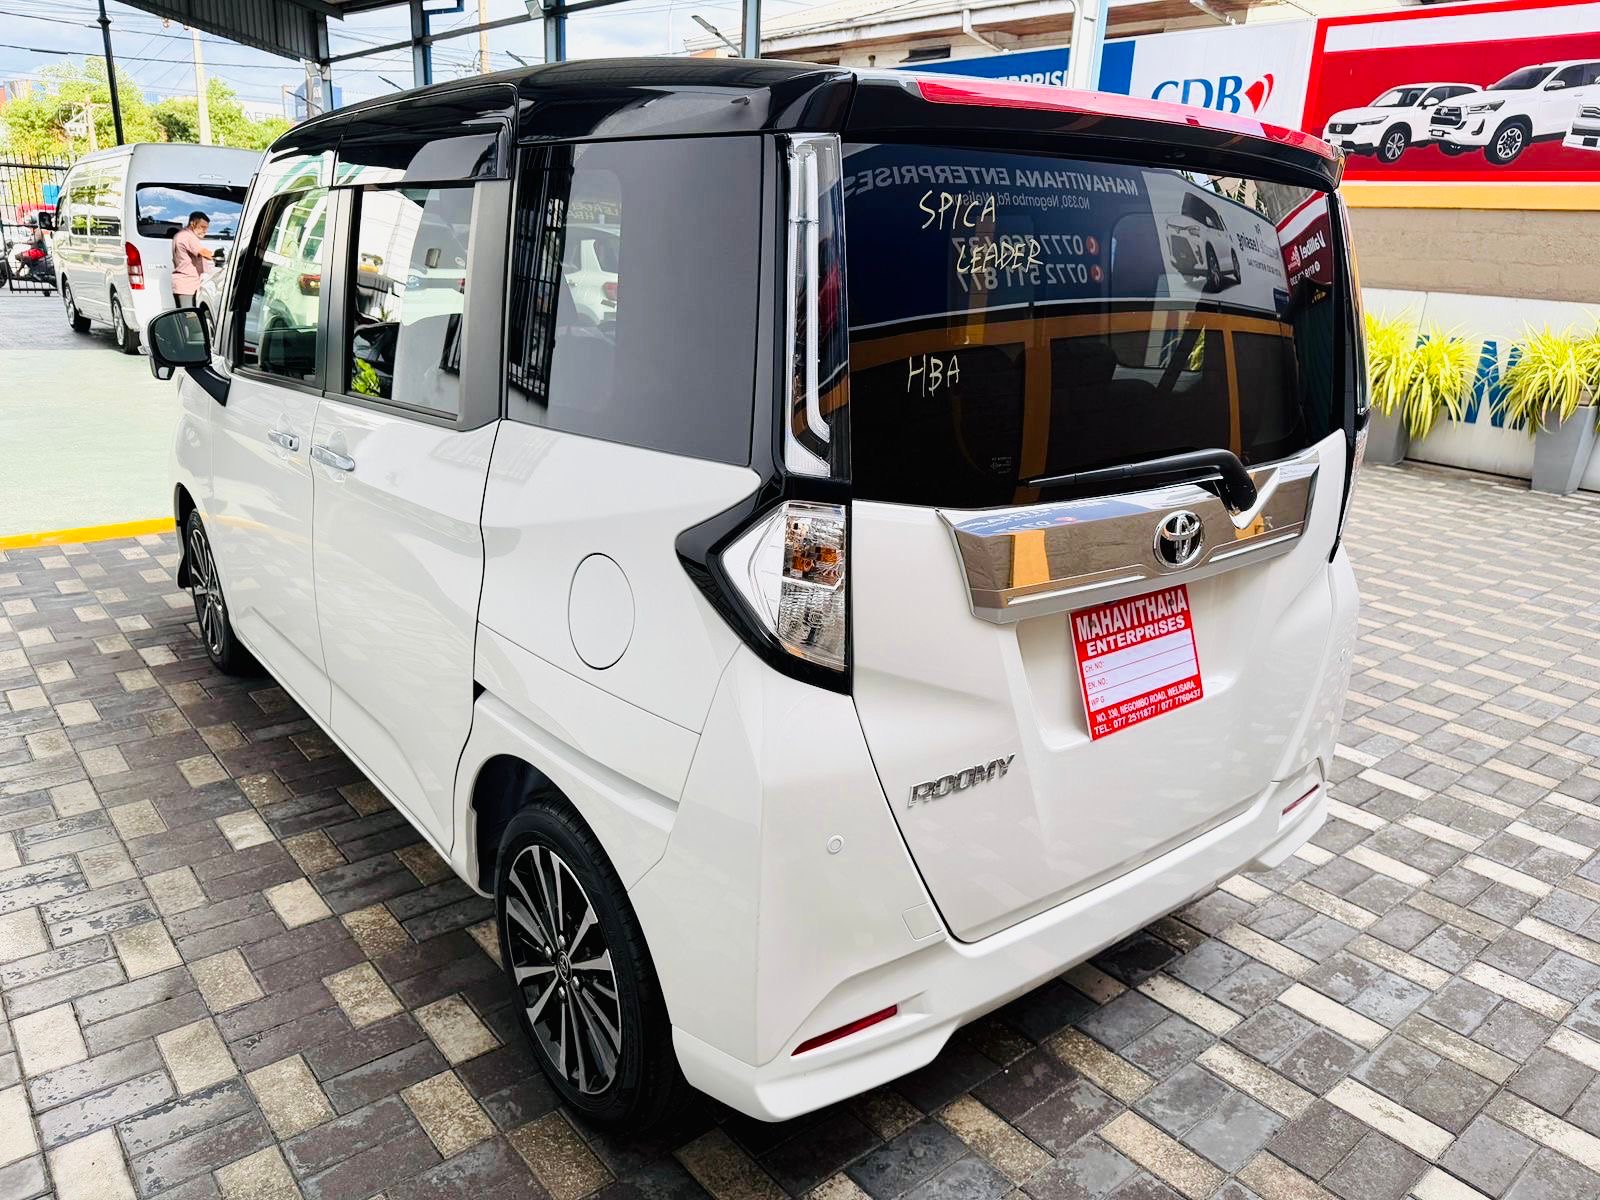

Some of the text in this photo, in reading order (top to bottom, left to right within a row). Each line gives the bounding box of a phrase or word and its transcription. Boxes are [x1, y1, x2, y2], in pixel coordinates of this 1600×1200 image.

[919, 190, 996, 231] SPICA
[956, 238, 1044, 273] LEADER
[907, 353, 960, 398] HBA
[1075, 589, 1188, 642] MAHAVITHANA
[1086, 615, 1186, 657] ENTERPRISES
[1094, 723, 1112, 736] TEL:
[1113, 716, 1127, 728] 077
[1128, 705, 1156, 724] 2511877
[1161, 699, 1173, 710] 077
[1096, 712, 1107, 724] NO.
[1120, 696, 1151, 715] NEGOMBO
[907, 752, 1015, 808] ROOMY
